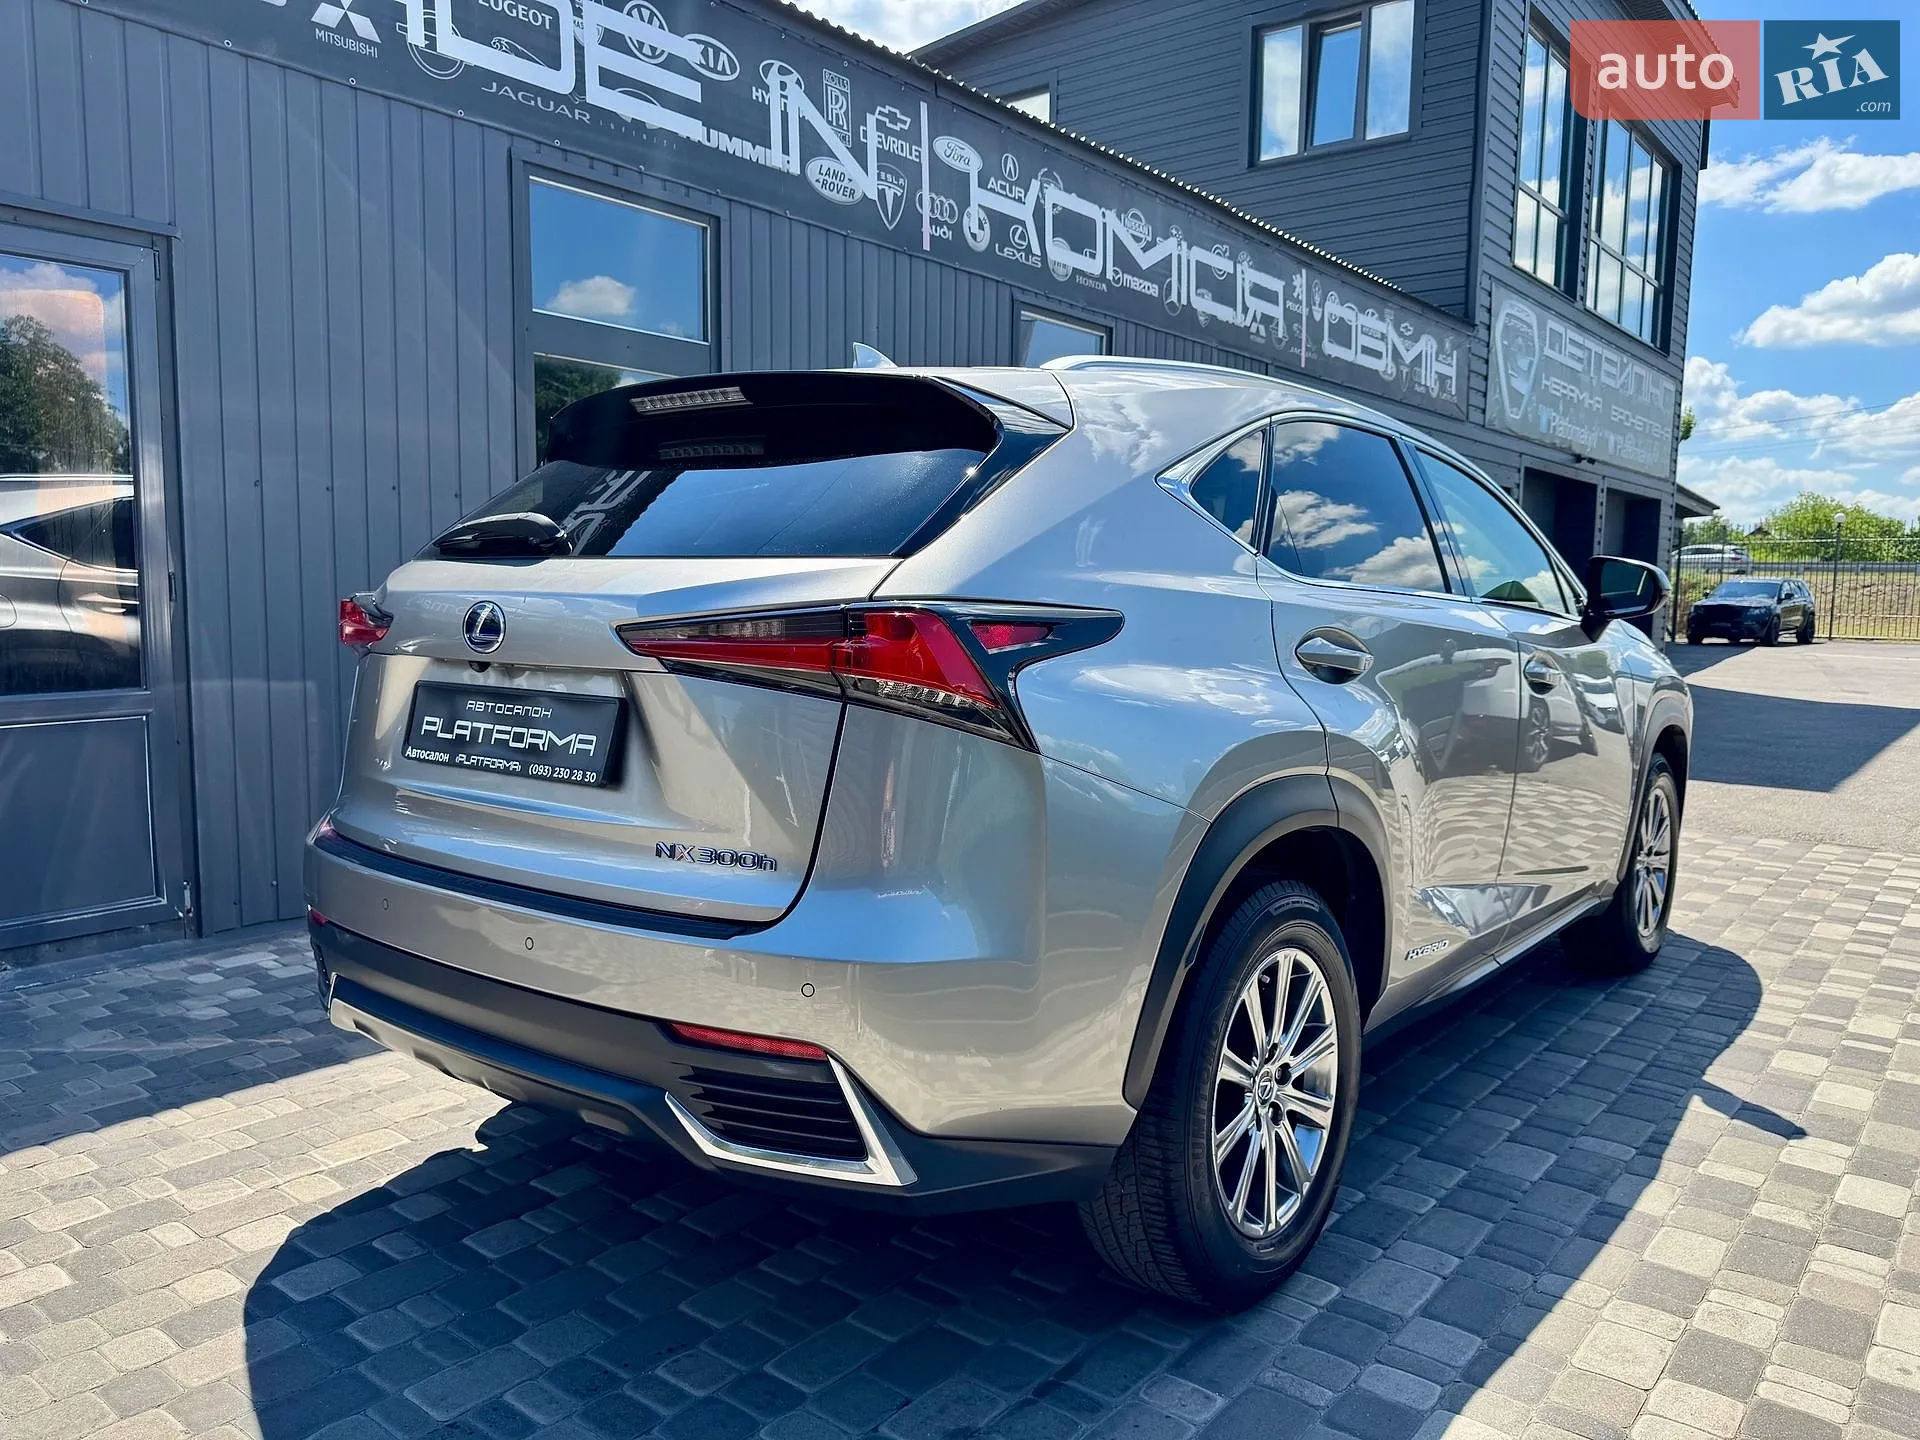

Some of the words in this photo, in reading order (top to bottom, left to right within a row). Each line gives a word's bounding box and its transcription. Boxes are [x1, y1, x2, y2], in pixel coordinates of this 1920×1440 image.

[315, 28, 378, 59] MITSUBISHI
[481, 81, 591, 125] JAGUAR
[944, 141, 971, 167] Ford
[818, 164, 846, 183] LAND
[820, 179, 856, 199] ROVER
[987, 176, 1028, 203] ACUR
[995, 242, 1042, 268] LEXUS
[1076, 274, 1108, 294] HONDA
[466, 700, 552, 718] АВТОСАЛОН
[421, 716, 597, 756] PLATFORMA
[405, 746, 450, 763] Автосалон
[528, 763, 552, 778] (093)
[553, 766, 570, 779] 230
[571, 768, 584, 781] 28
[584, 770, 597, 783] 30
[1404, 939, 1449, 960] HYBRID
